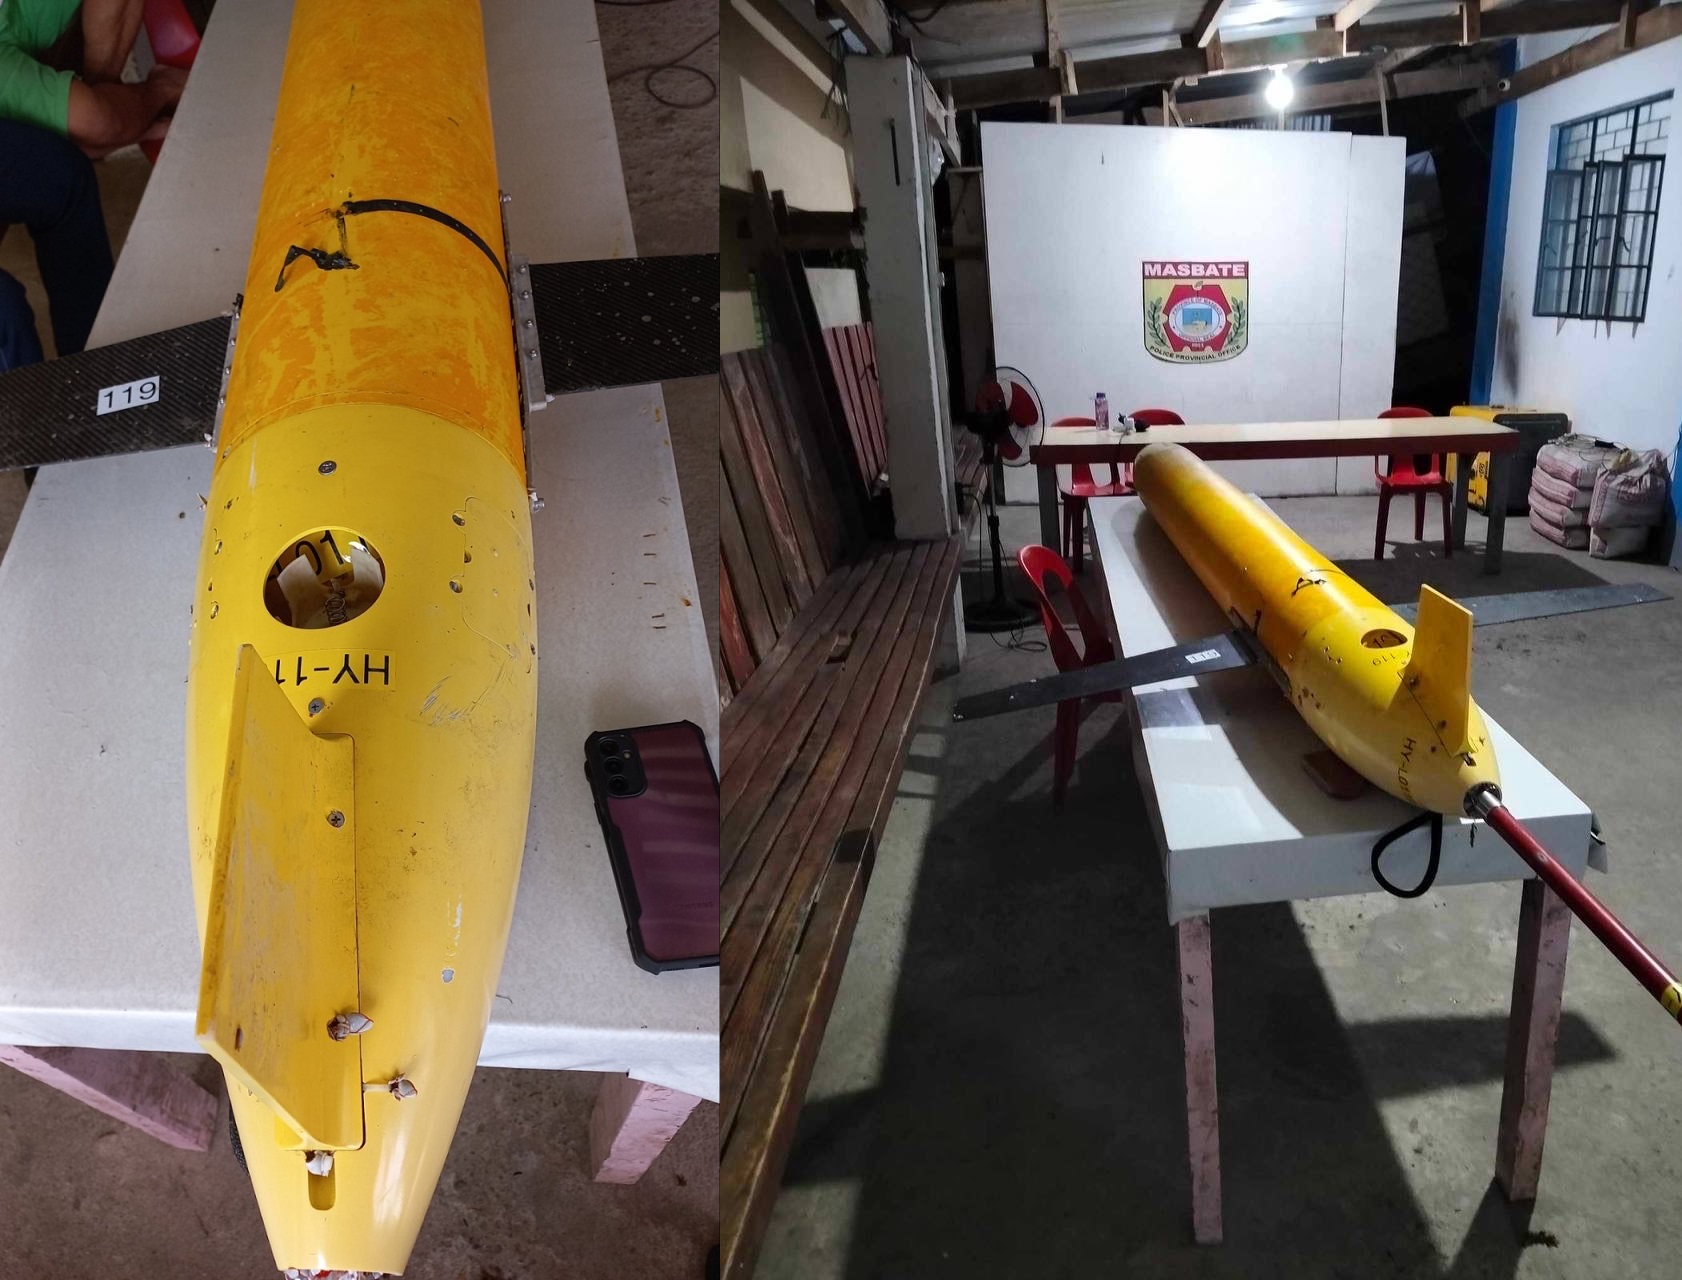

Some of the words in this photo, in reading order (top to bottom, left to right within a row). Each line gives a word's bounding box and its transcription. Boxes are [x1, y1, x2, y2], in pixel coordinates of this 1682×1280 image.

[1144, 263, 1246, 277] MASBATE
[1149, 345, 1174, 359] POLICE
[1175, 353, 1216, 361] PROVINCIAL
[1217, 345, 1241, 358] OFFICE
[103, 381, 156, 409] 119
[275, 653, 390, 686] HY-11
